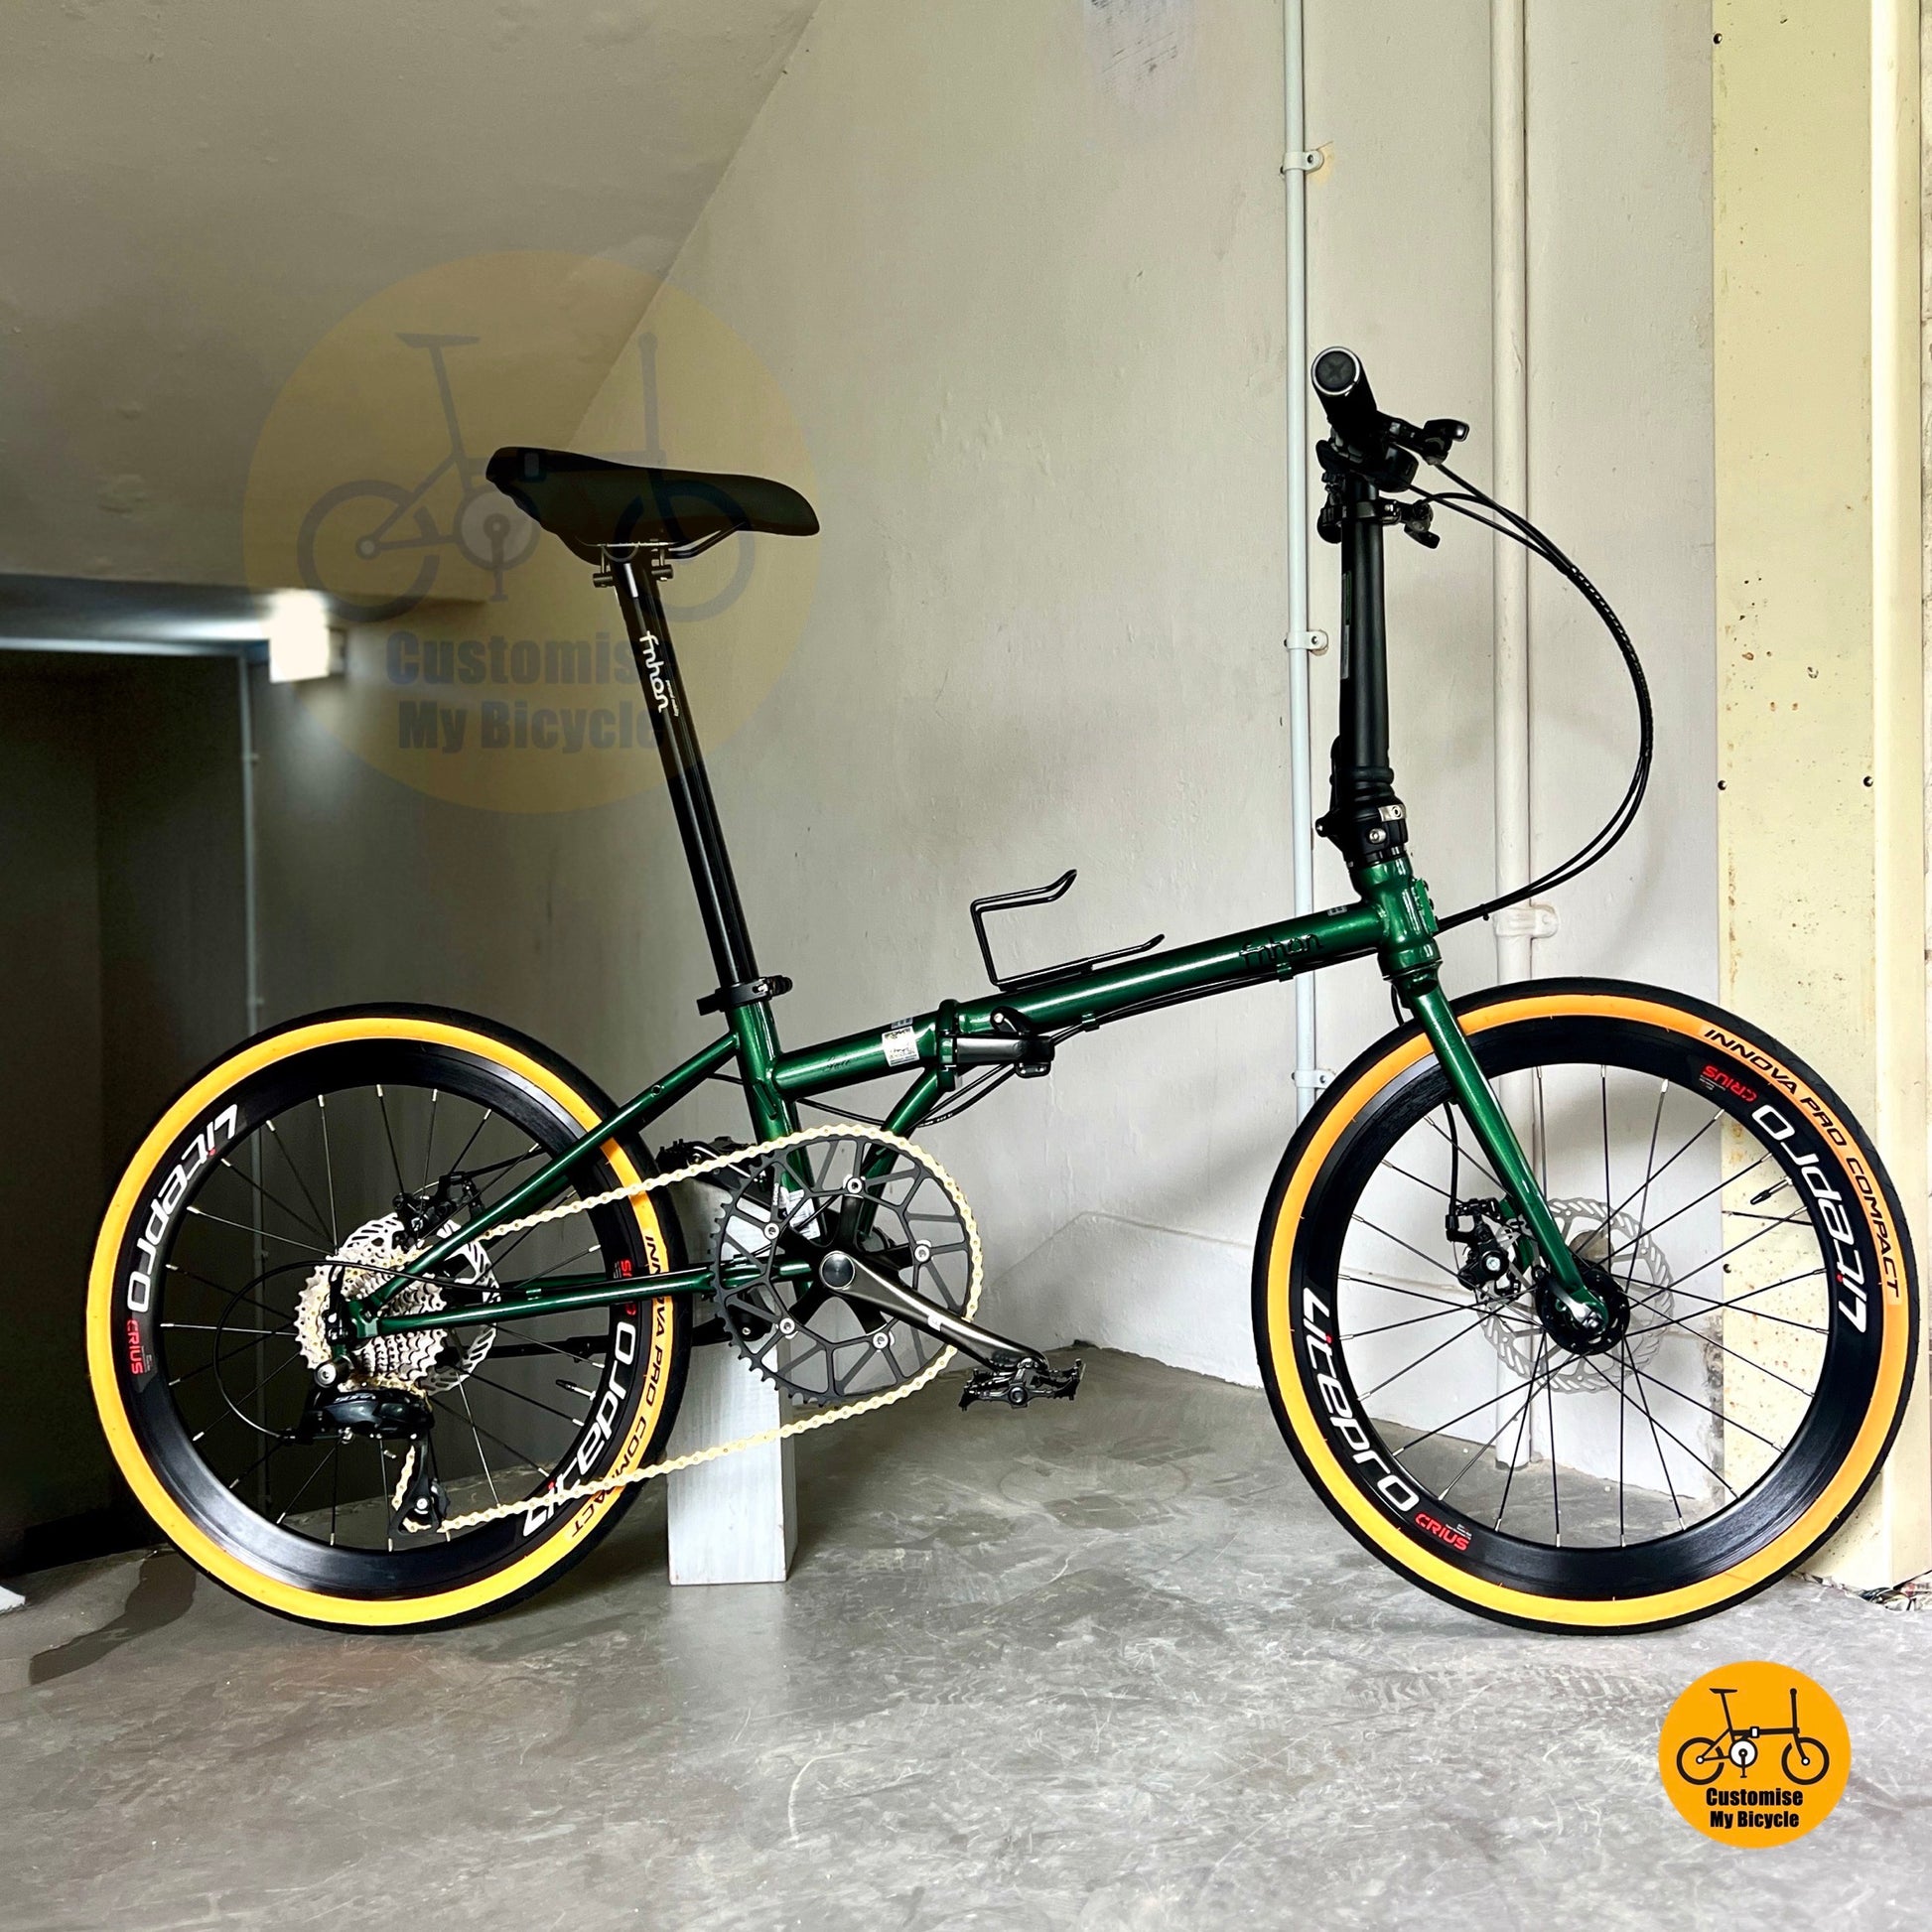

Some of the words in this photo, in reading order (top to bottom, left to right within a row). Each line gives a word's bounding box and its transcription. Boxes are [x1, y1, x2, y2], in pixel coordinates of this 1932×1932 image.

[1703, 1065, 1758, 1103] CRIUS
[1704, 1029, 1798, 1095] INNOVA
[1800, 1097, 1847, 1147] PRO
[1846, 1157, 1900, 1299] COMPACT
[127, 1318, 144, 1375] CRIUS
[645, 1344, 663, 1407] PRO
[571, 1416, 647, 1538] COMACT
[1415, 1512, 1470, 1552] CRIUS
